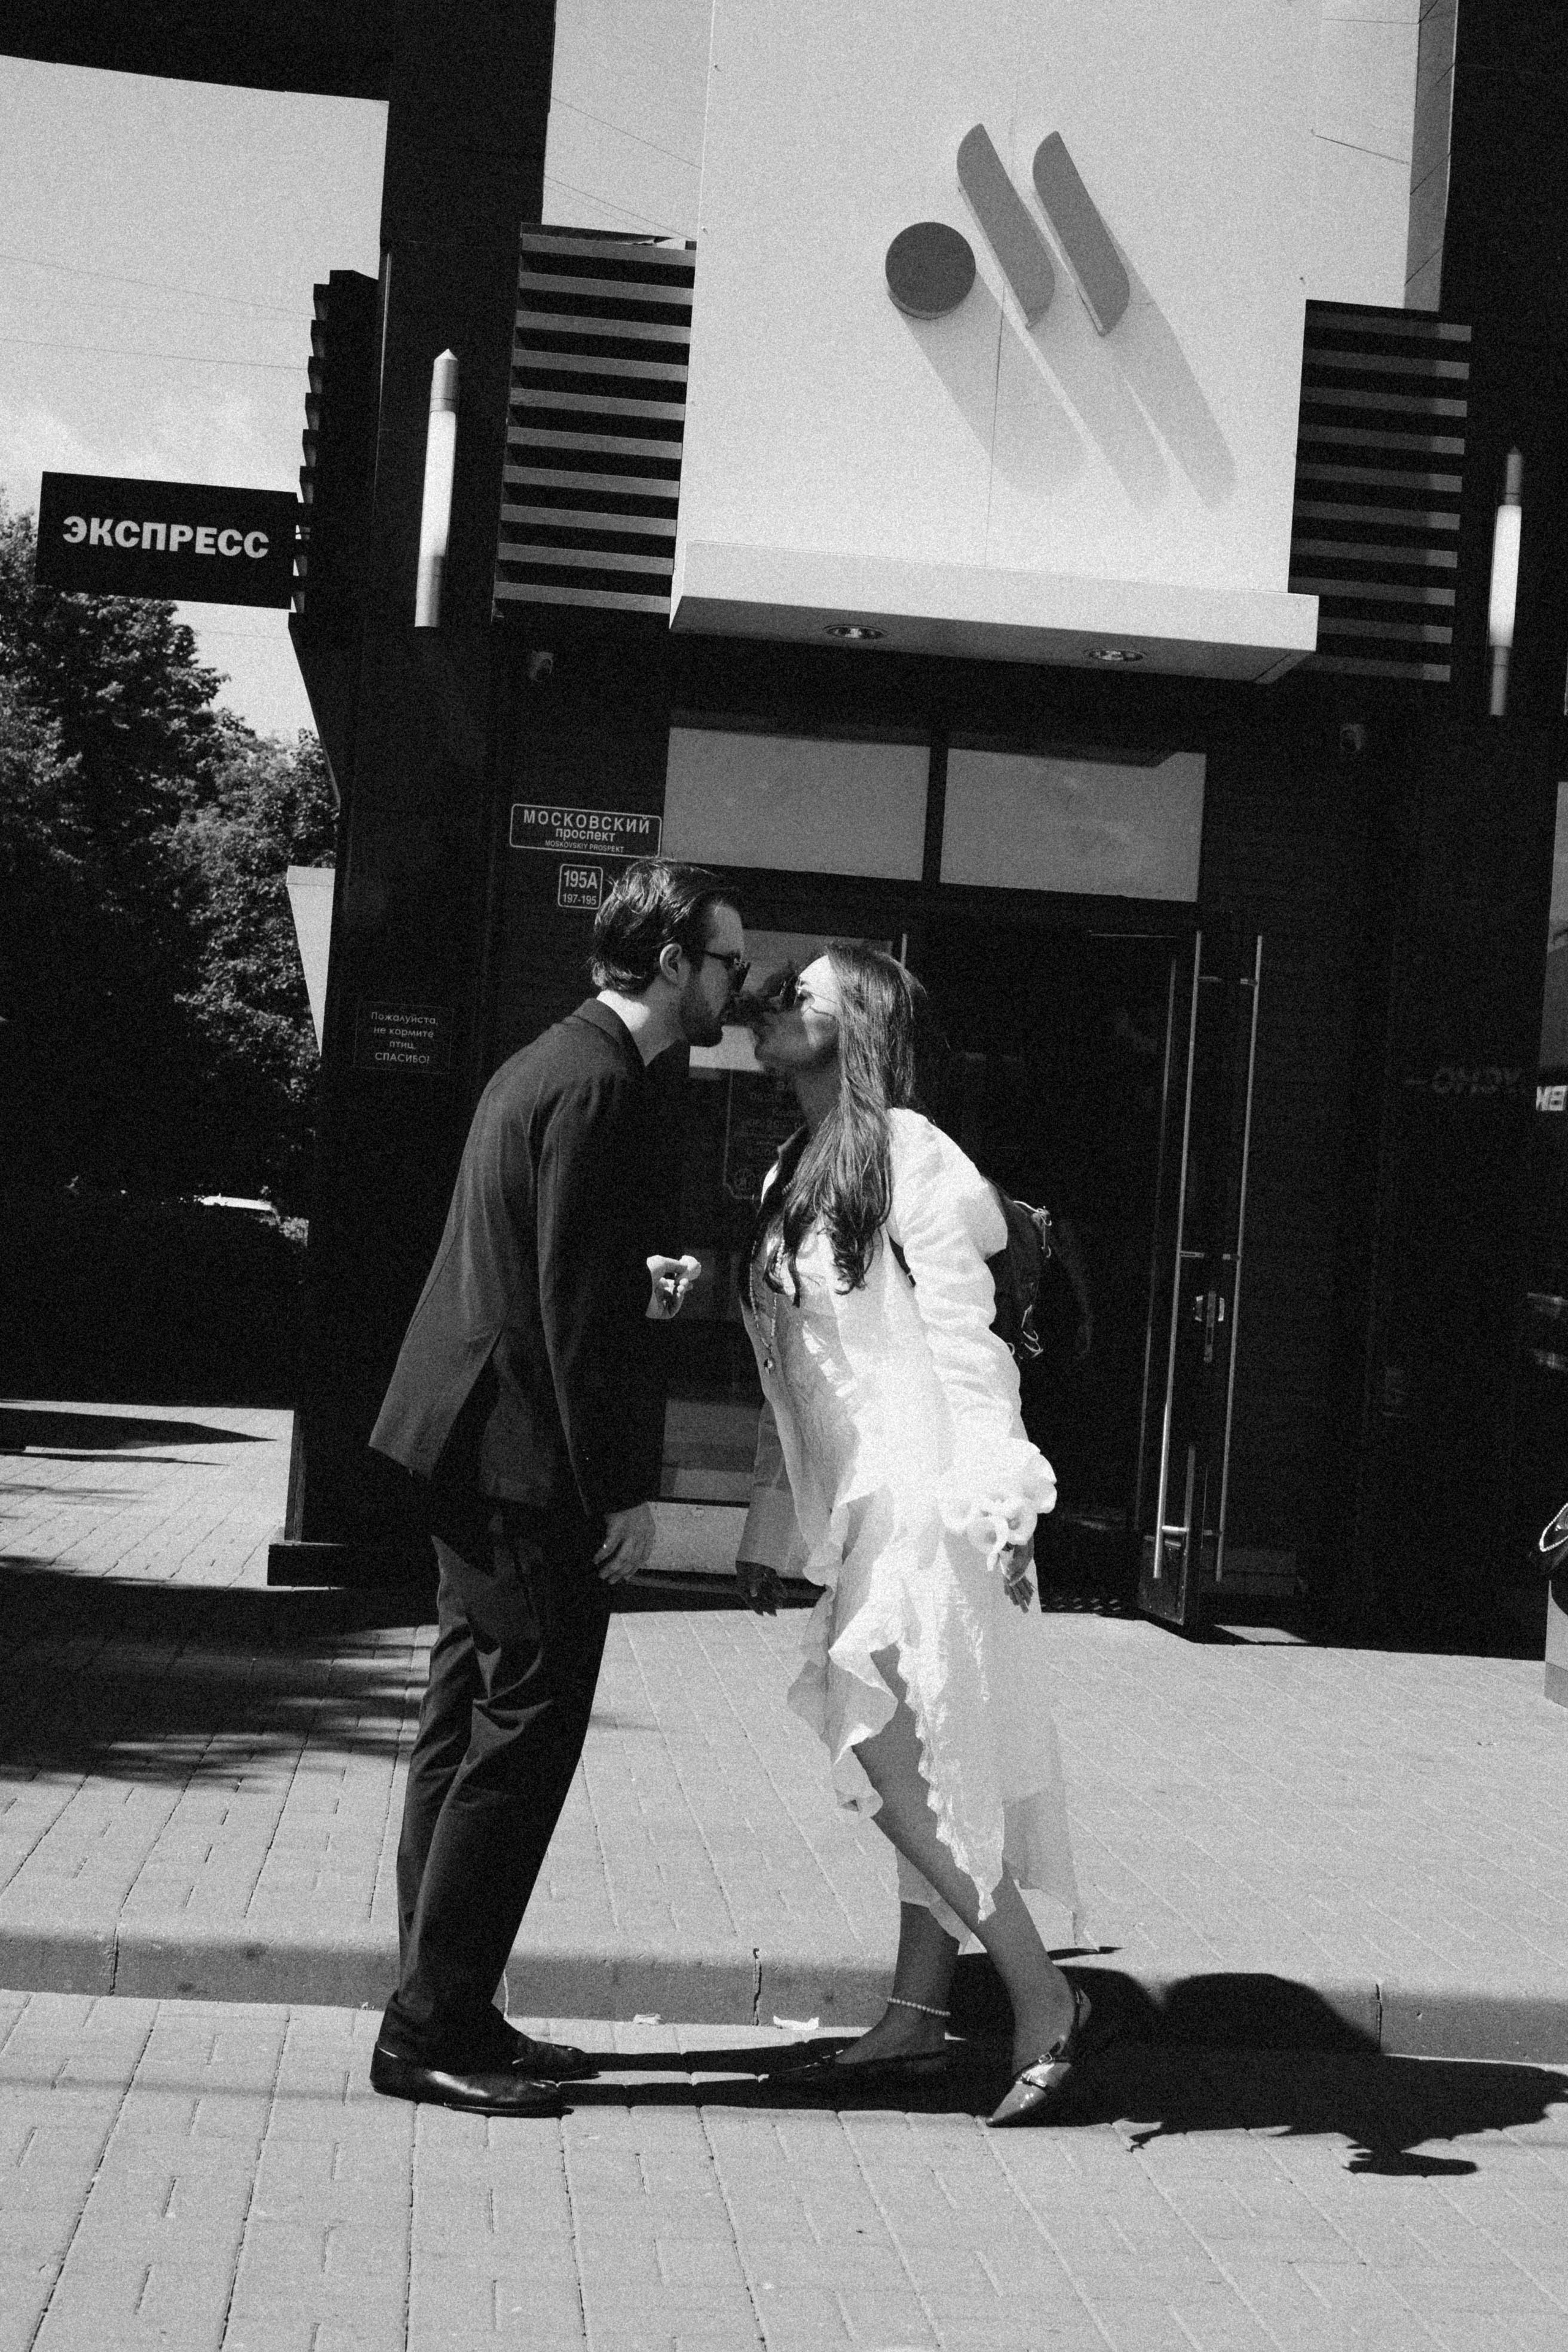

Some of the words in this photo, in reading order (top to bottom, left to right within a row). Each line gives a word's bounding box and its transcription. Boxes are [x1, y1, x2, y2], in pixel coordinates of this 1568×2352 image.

[62, 516, 270, 559] ЭКСПРЕСС
[523, 809, 650, 834] МОСКОВСКИЙ
[555, 828, 616, 842] проспект
[545, 840, 588, 850] MOSKOVSKIY
[589, 843, 625, 853] PROSPEKT
[564, 870, 598, 889] 195А
[562, 893, 597, 905] 197-195
[389, 1028, 434, 1038] кормите
[374, 1052, 430, 1064] СПАСИБО!
